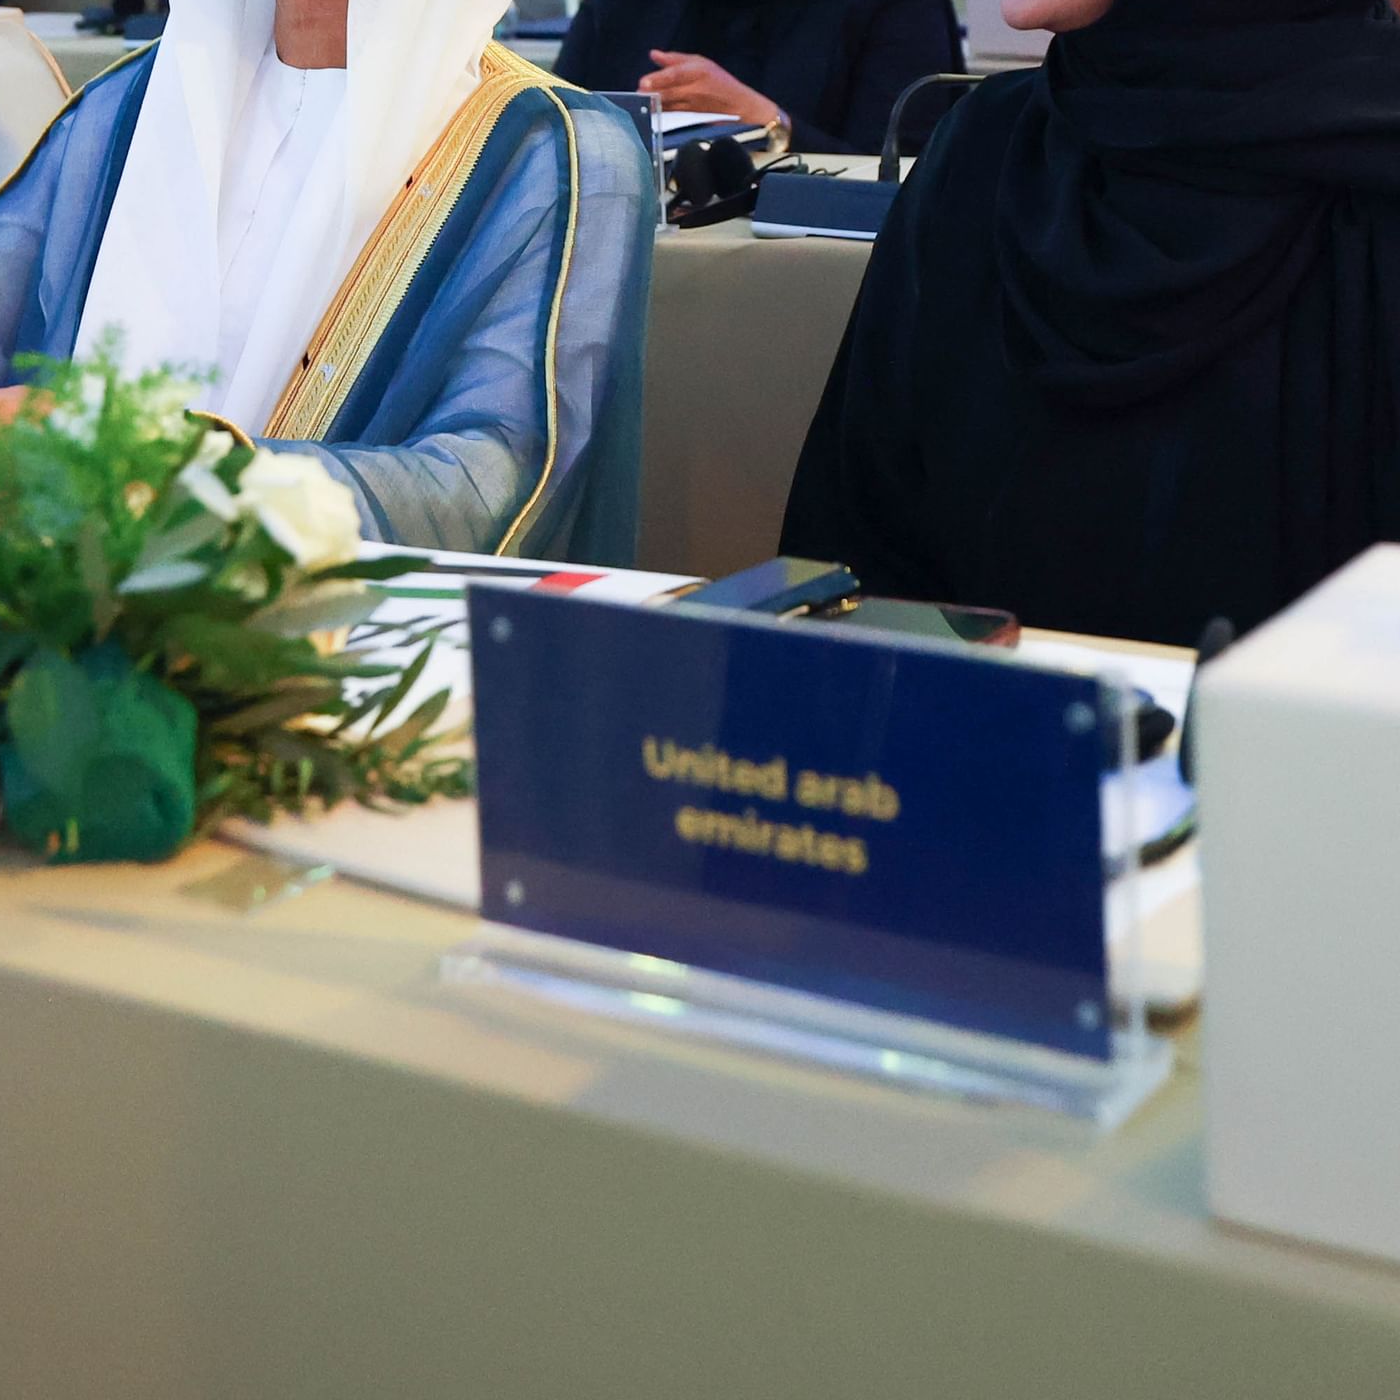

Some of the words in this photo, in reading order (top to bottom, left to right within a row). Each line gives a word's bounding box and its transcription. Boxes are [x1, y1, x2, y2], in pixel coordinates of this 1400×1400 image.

[642, 736, 788, 800] United
[795, 772, 900, 821] arab
[675, 806, 868, 875] emirates
